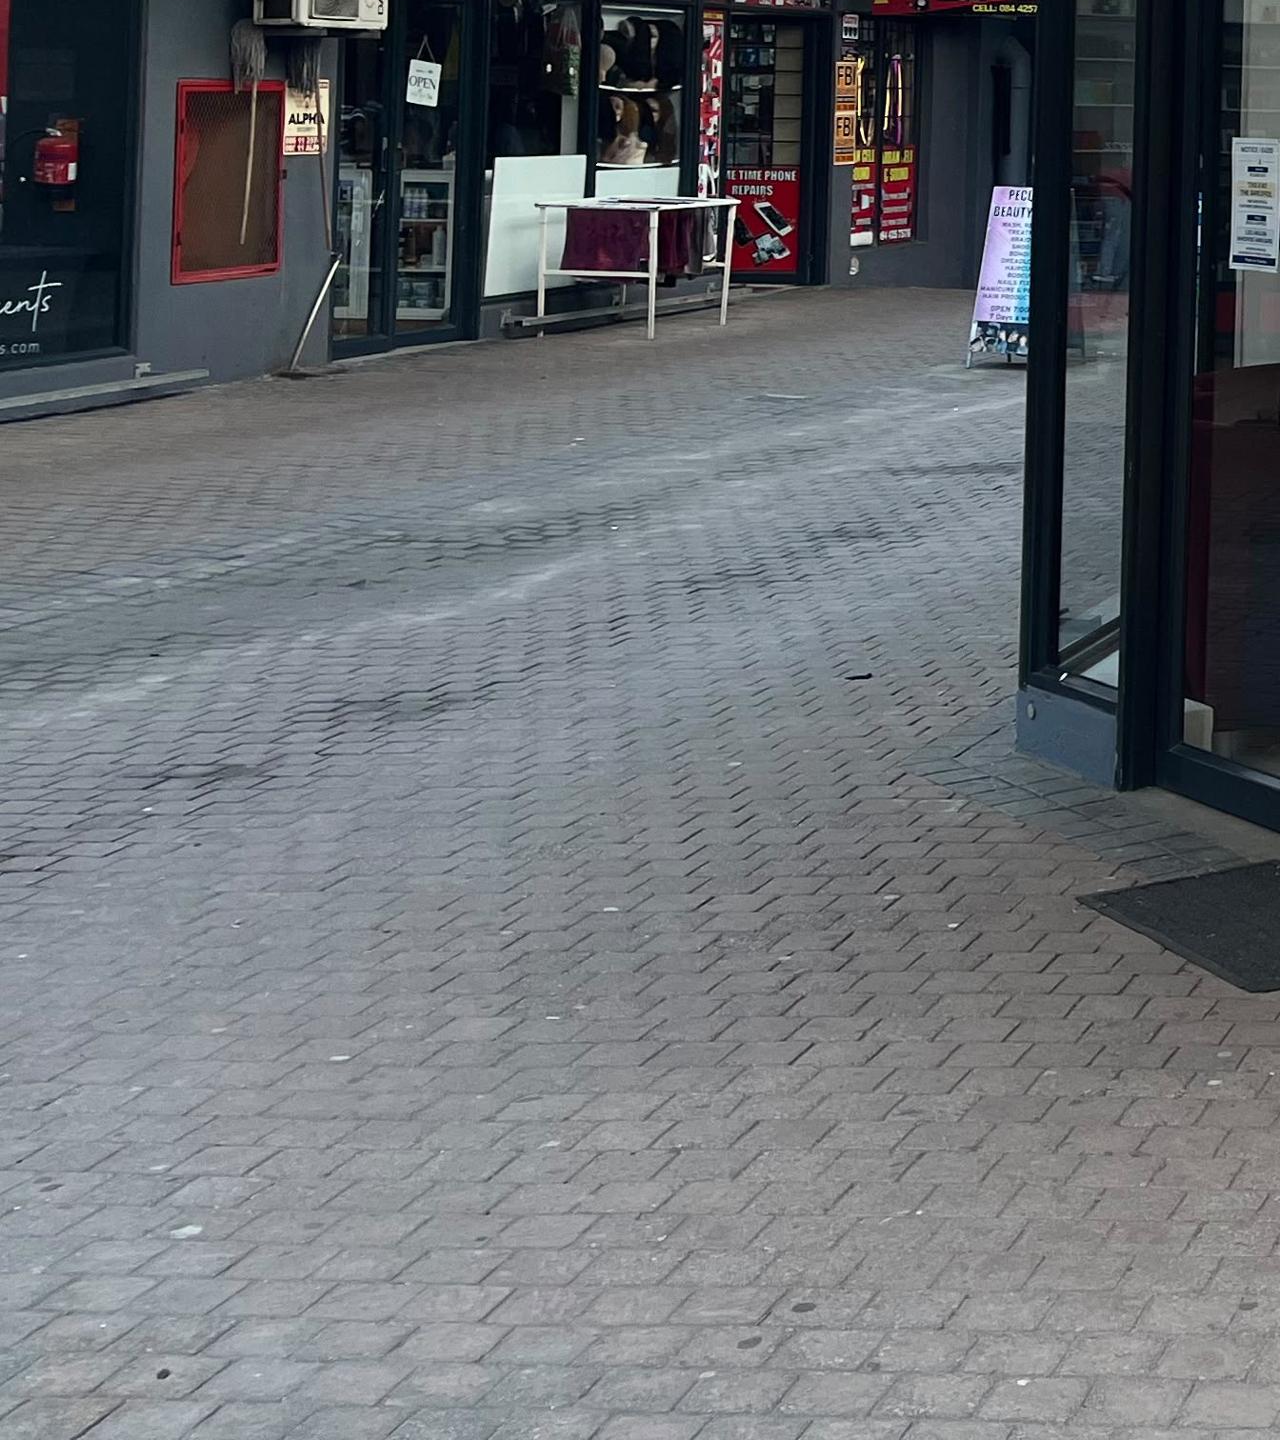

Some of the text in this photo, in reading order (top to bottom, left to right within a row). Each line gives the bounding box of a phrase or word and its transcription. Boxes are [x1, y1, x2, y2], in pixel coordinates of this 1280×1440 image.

[408, 75, 436, 90] OPEN
[738, 170, 763, 181] TIME
[764, 170, 797, 181] PHONE
[731, 184, 774, 196] REPAIRS
